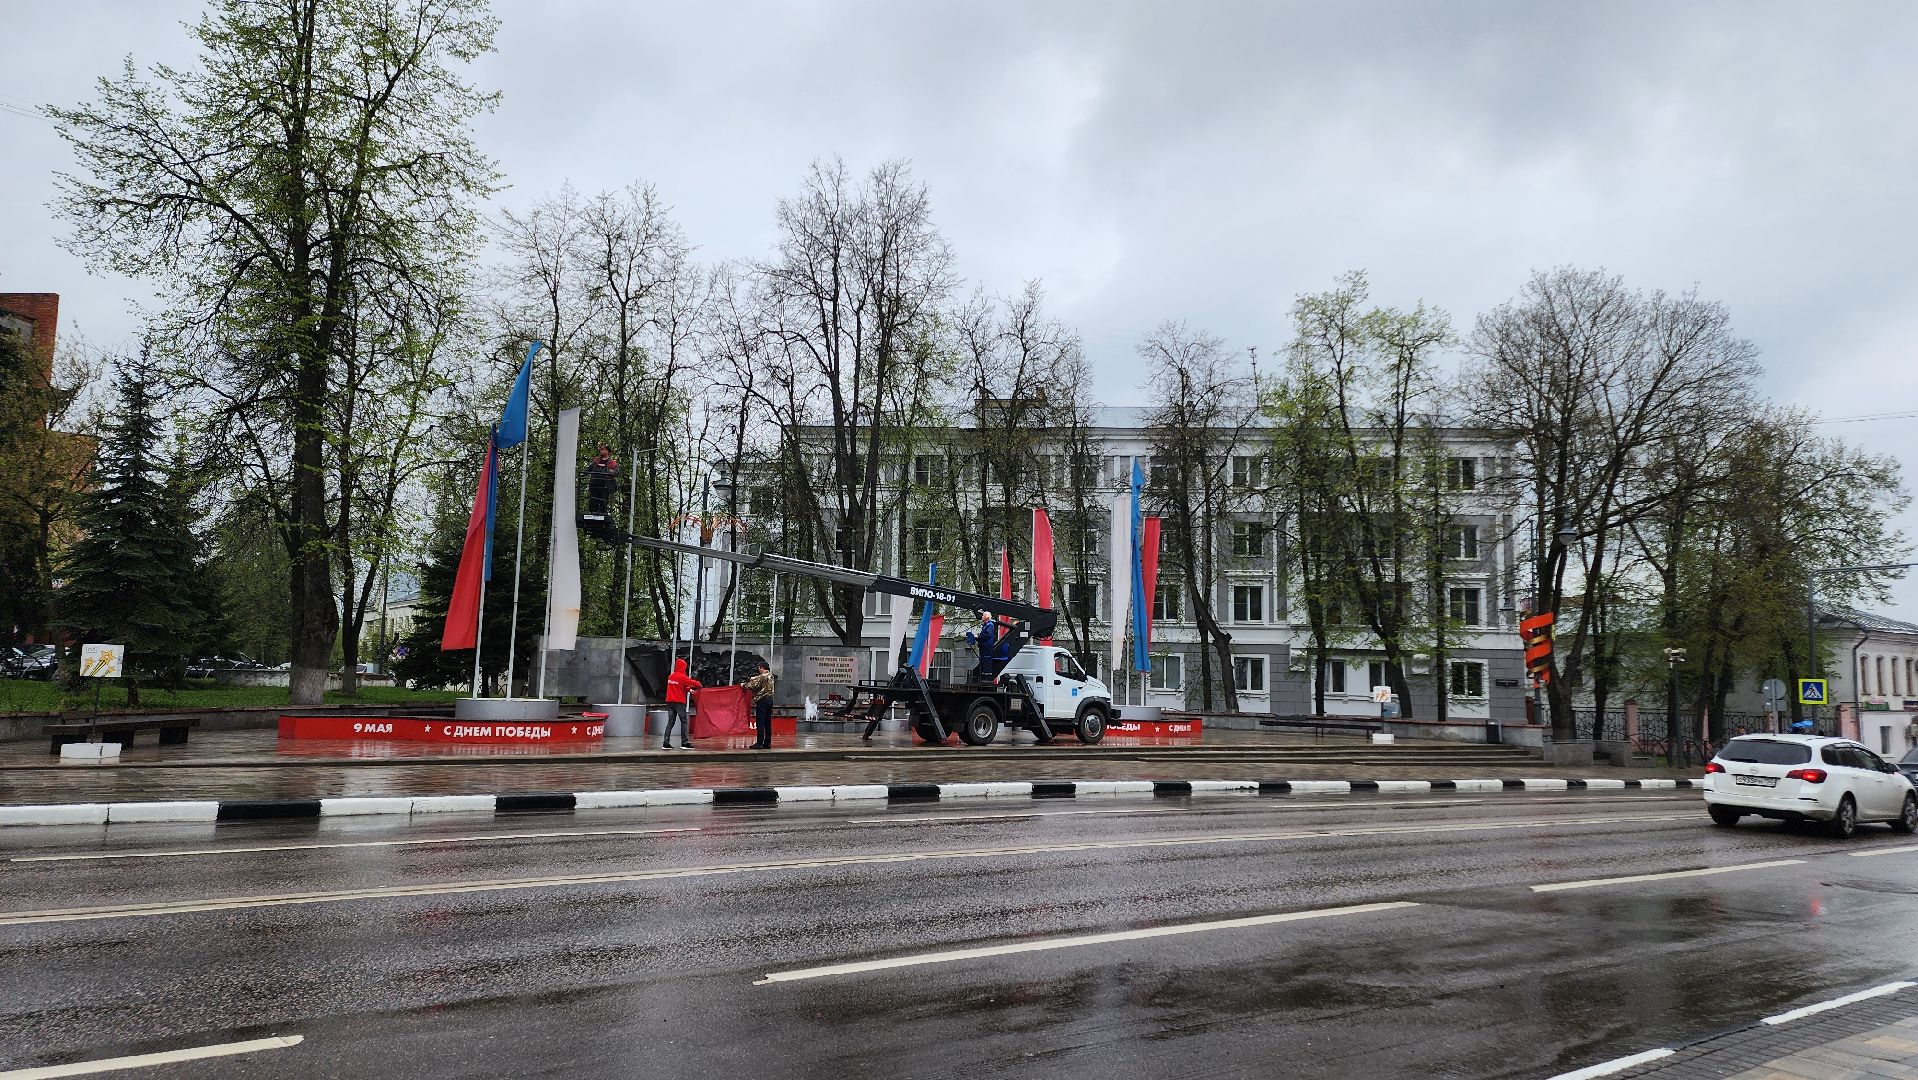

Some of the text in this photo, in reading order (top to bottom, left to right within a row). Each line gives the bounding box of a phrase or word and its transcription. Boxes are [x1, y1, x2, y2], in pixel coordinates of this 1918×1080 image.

[910, 587, 956, 602] ВИПО-18-01
[353, 722, 393, 734] 9 МАЯ
[443, 726, 551, 740] С ДНЕМ ПОБЕДЫ
